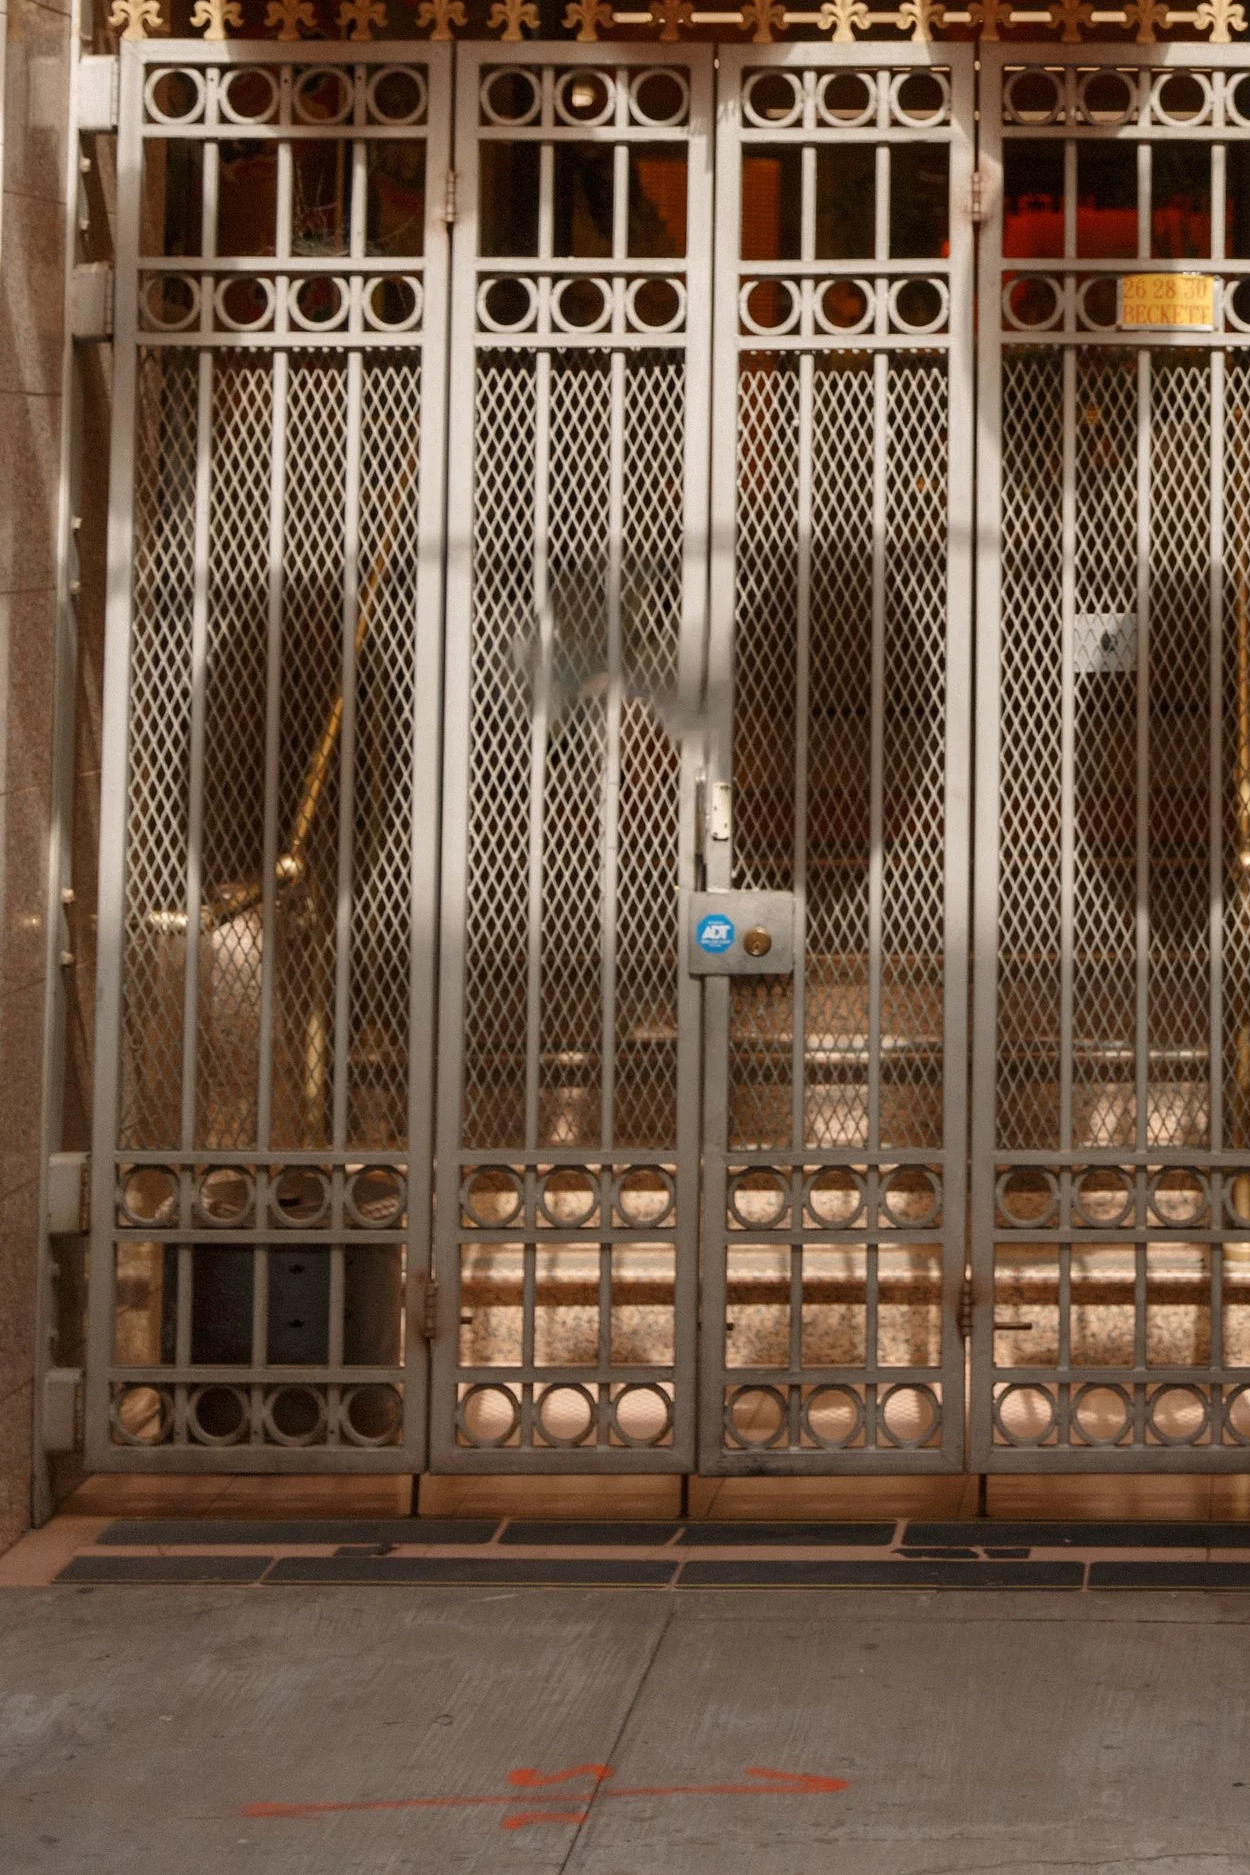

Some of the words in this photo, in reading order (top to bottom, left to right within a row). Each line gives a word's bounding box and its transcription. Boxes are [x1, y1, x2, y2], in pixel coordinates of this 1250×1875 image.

[1124, 278, 1147, 300] 26
[1152, 278, 1177, 300] 28
[1183, 277, 1207, 300] 30
[1123, 303, 1210, 325] BECKETT
[701, 925, 731, 940] ADT
